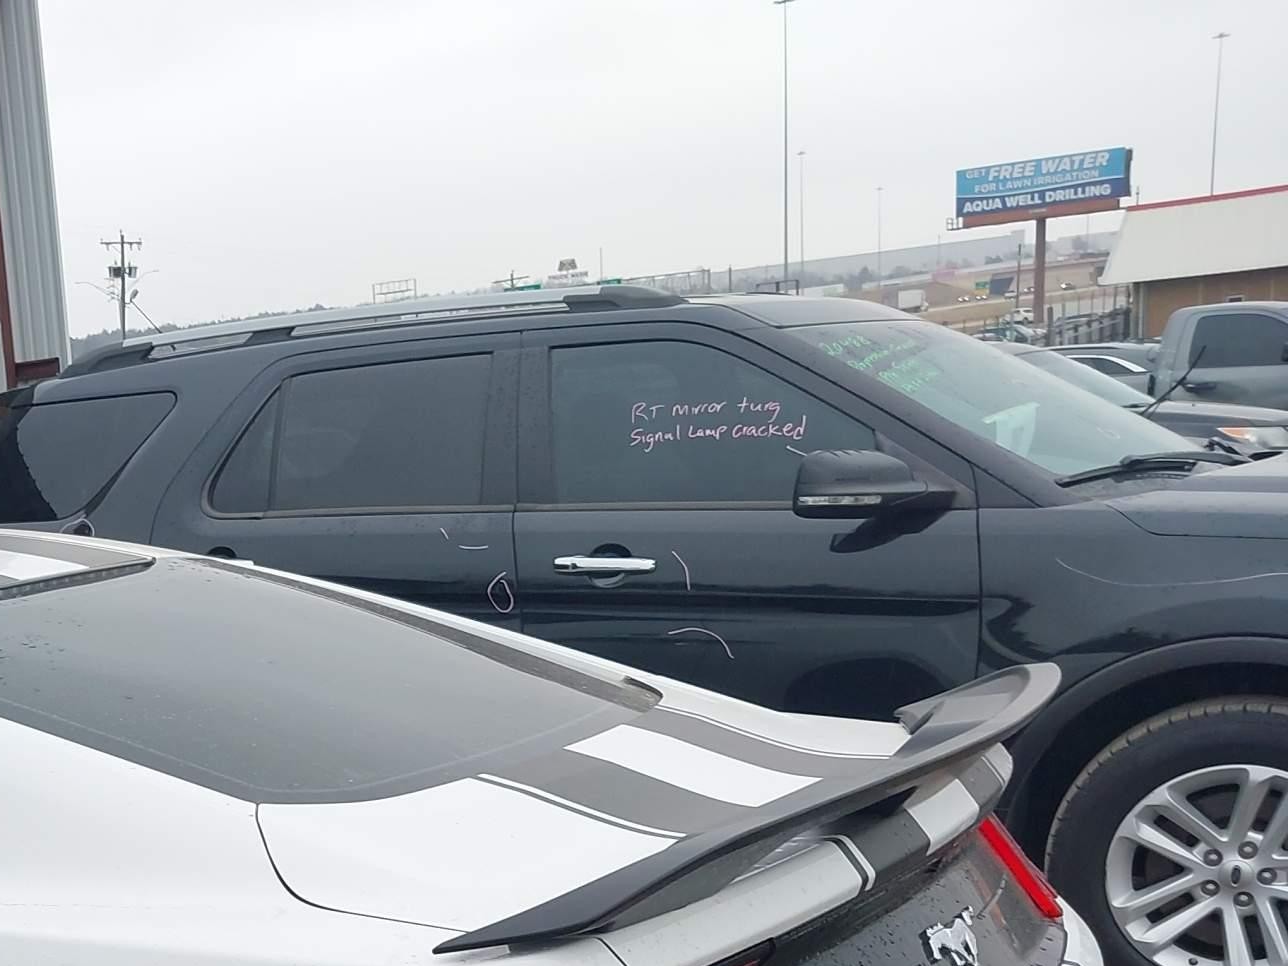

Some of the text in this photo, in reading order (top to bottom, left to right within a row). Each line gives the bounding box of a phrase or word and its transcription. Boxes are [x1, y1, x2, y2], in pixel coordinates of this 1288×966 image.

[966, 152, 1110, 181] GET FREE WATER
[974, 169, 1099, 193] FOR LAWN IRRIGATION
[963, 184, 1111, 213] AQUA WELL DRILLING
[632, 402, 665, 424] RT
[630, 424, 680, 452] Signal
